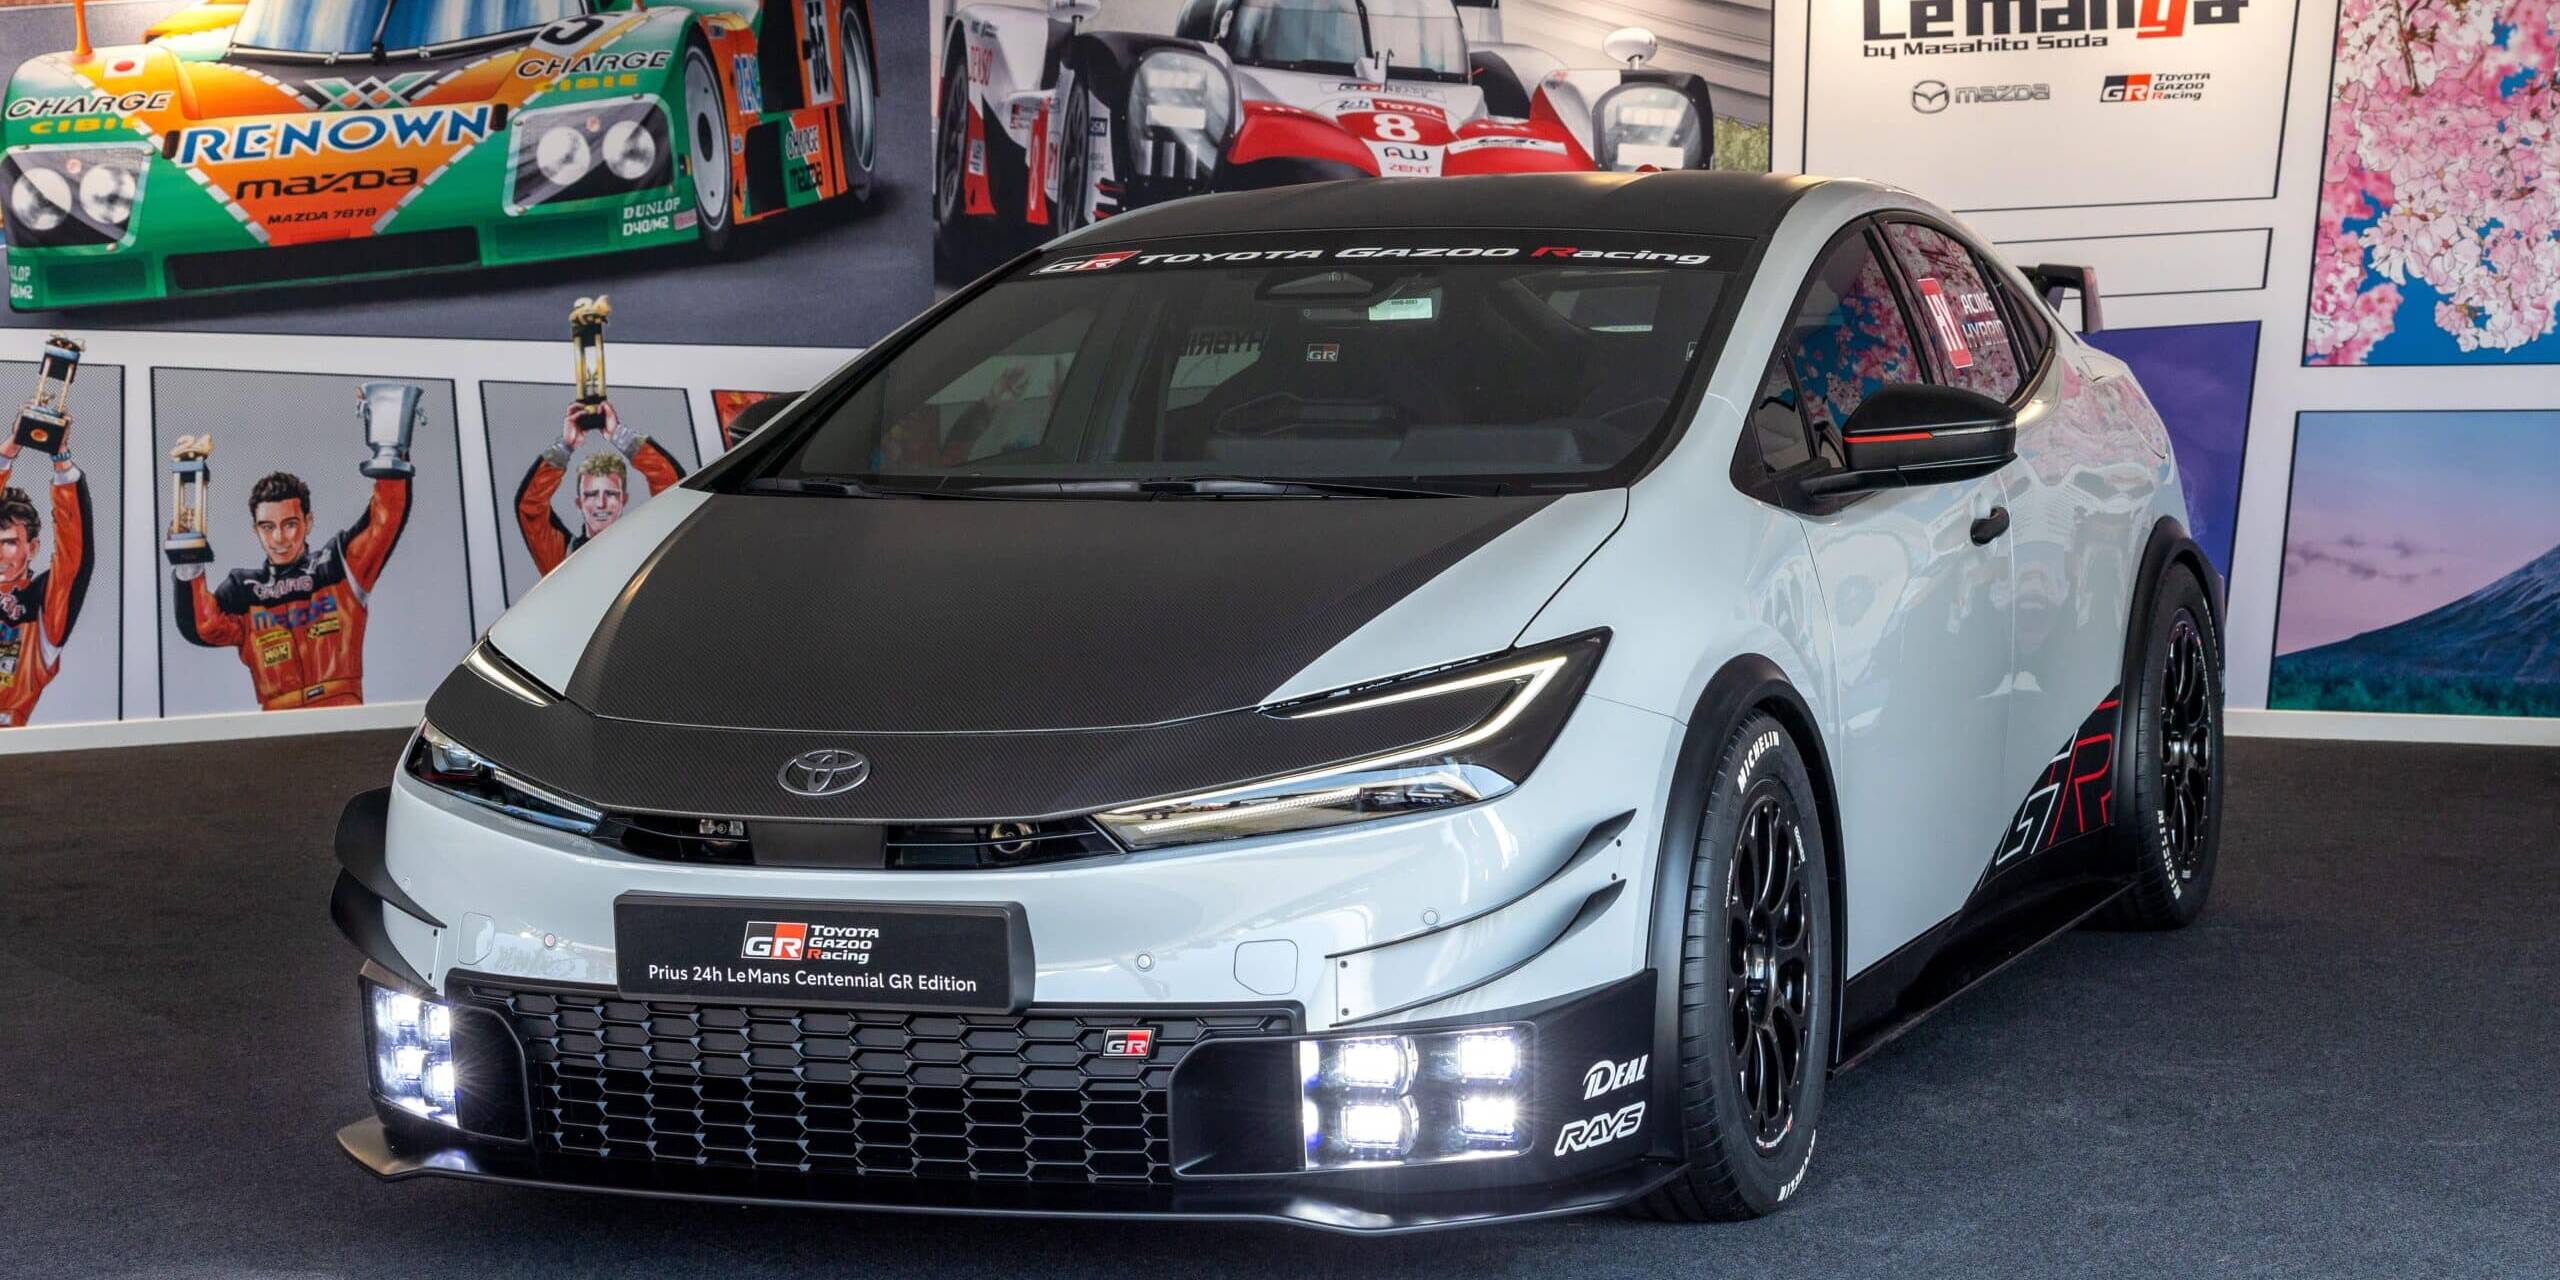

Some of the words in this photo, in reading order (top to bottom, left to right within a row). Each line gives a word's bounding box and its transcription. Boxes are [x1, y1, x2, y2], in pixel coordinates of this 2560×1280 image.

[1863, 45, 1896, 60] by
[1903, 38, 2029, 56] Masahito
[2036, 35, 2109, 50] Soda
[516, 51, 672, 79] CHARGE
[2156, 72, 2211, 82] TOYOTA
[2151, 90, 2202, 101] Racing
[2153, 82, 2205, 91] GAZOO
[6, 91, 174, 120] CHARGE
[1374, 101, 1444, 119] TOTAL
[178, 104, 491, 167] RENOWN
[1373, 113, 1421, 143] 8
[267, 210, 329, 225] MAZDA
[622, 196, 681, 220] DUNLOP
[1137, 249, 1324, 265] TOYOTA
[1333, 247, 1520, 260] GAZOO
[1530, 246, 1711, 265] Racing
[1737, 730, 1780, 795] MICHELIN
[808, 937, 873, 950] GAZOO
[811, 924, 880, 939] TOYOTA
[743, 935, 804, 959] GR
[806, 948, 870, 965] Racing
[649, 964, 689, 982] Prius
[692, 966, 723, 983] 24h
[795, 970, 884, 988] Centennial
[888, 973, 913, 990] GR
[918, 974, 977, 993] Edition
[1553, 1100, 1646, 1158] RAYS
